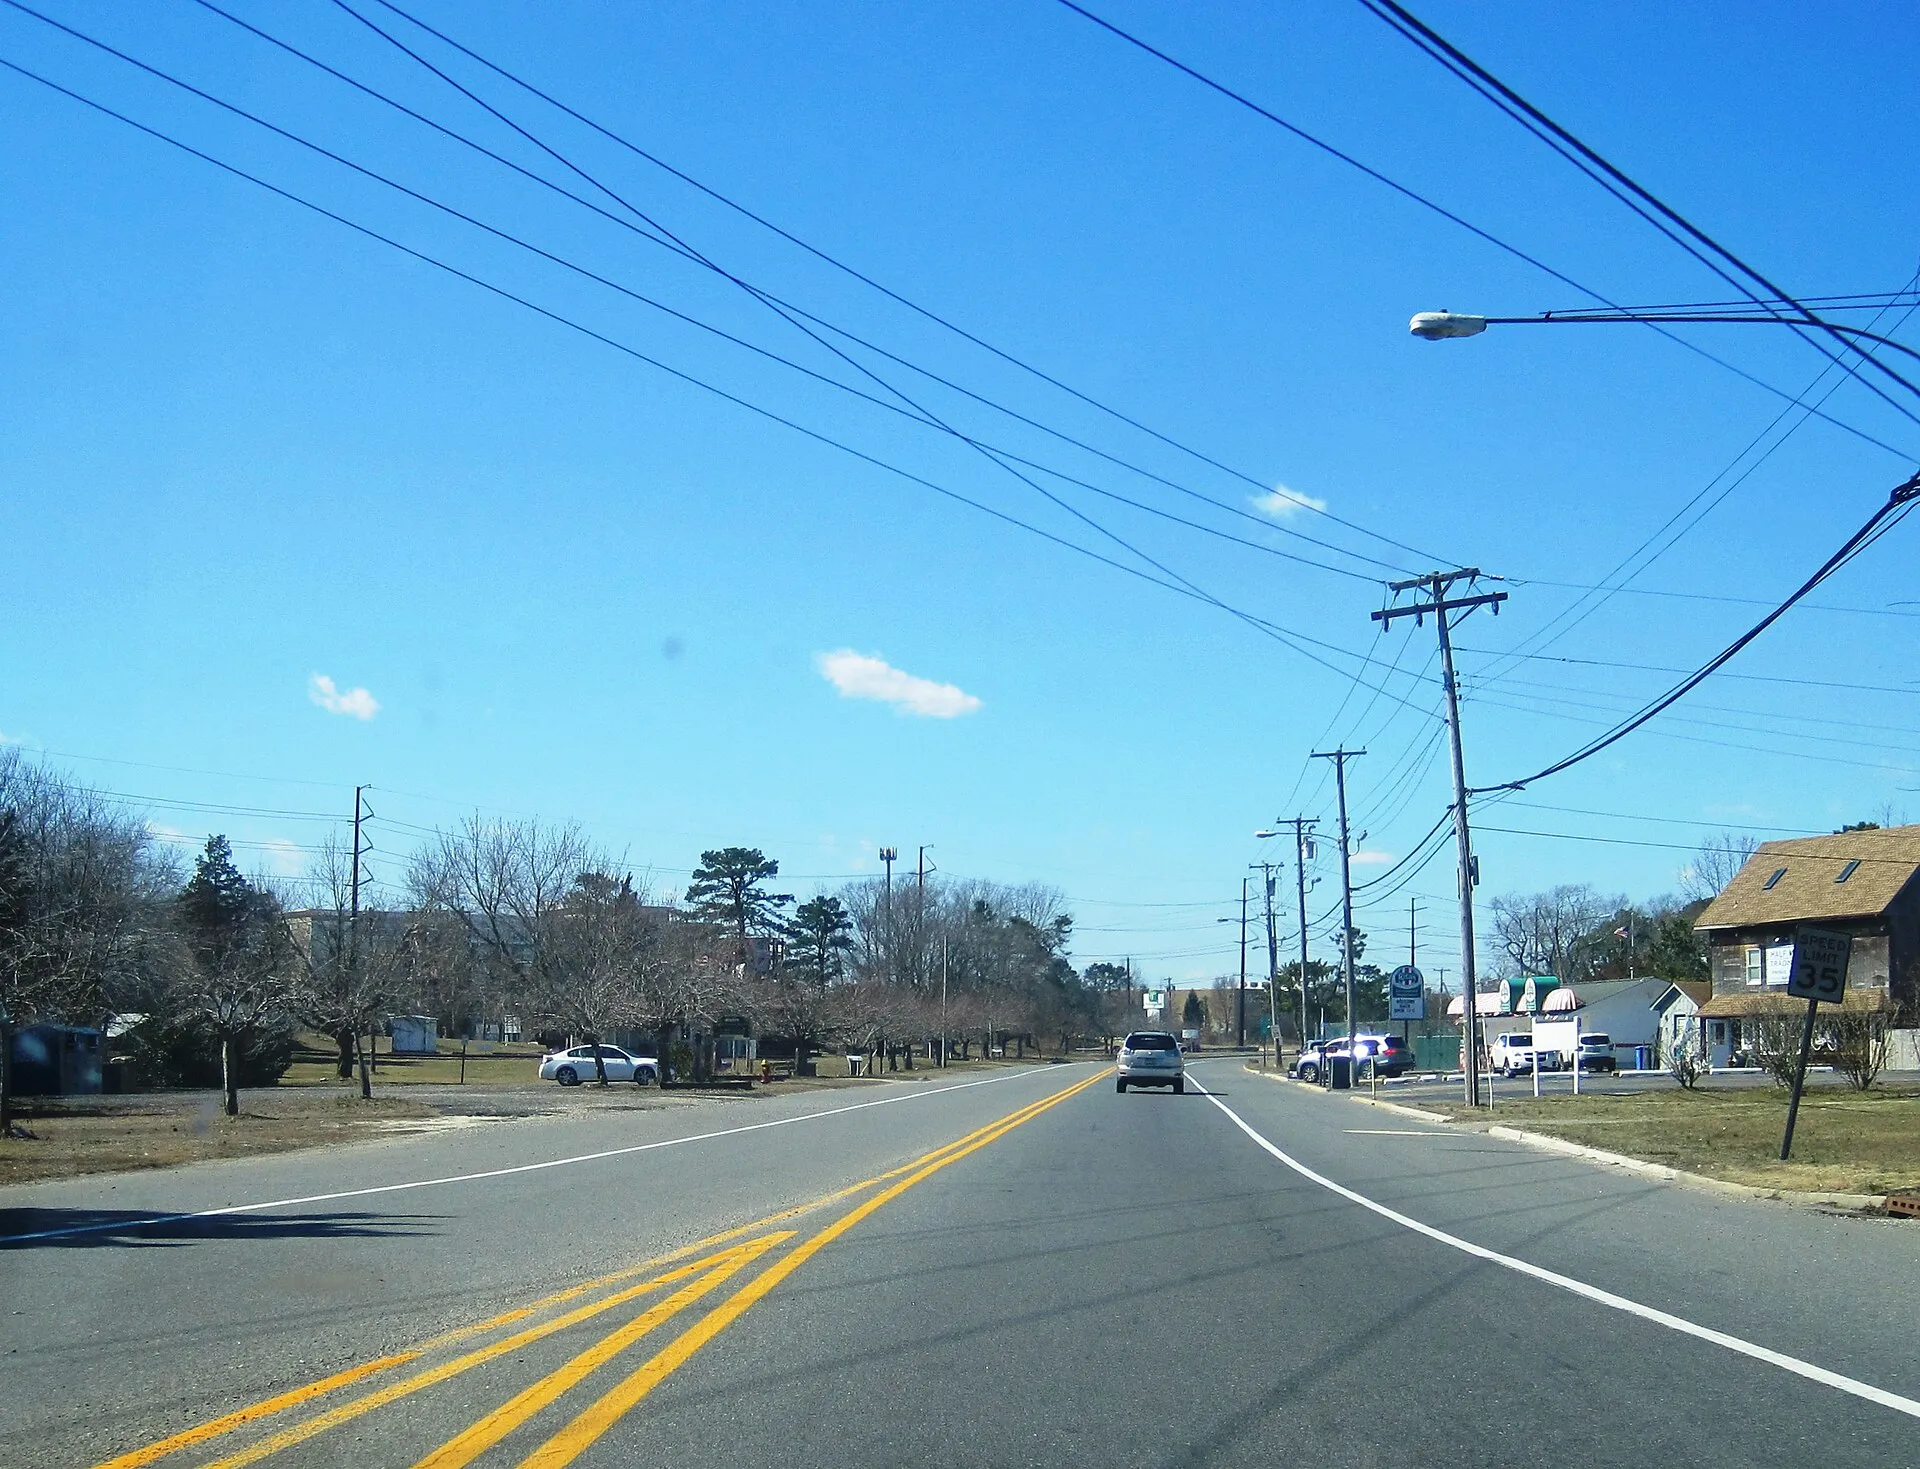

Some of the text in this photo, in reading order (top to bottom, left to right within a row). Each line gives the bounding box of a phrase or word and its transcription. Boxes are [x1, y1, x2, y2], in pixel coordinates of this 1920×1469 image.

[1800, 934, 1846, 951] SPEED
[1803, 949, 1839, 965] LIMIT
[1796, 964, 1839, 993] 35
